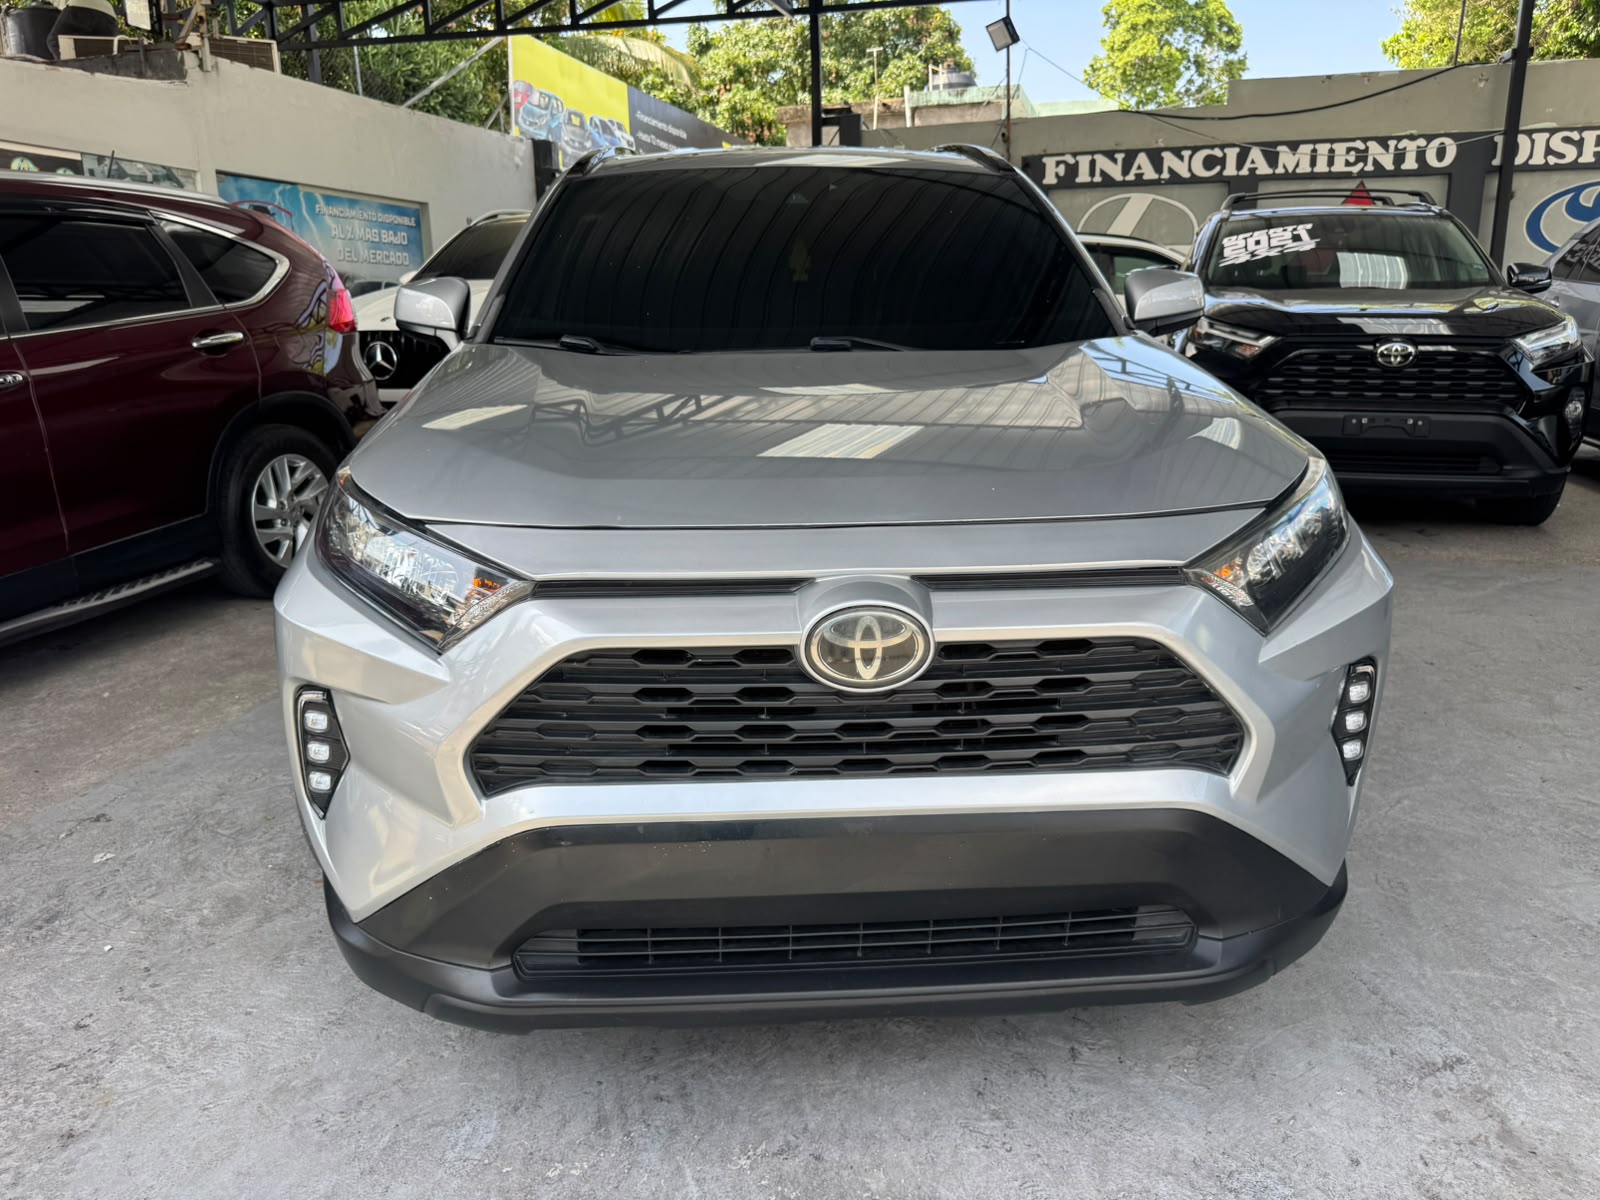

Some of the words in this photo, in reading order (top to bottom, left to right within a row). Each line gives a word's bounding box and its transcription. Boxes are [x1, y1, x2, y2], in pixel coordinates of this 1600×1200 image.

[1042, 136, 1458, 185] FINANCIAMIENTO
[316, 204, 376, 222] FINANCIAMIENTO
[377, 212, 416, 227] DISPONIBLE
[331, 223, 345, 239] AL
[356, 226, 379, 242] MAS
[381, 228, 408, 245] BAJO
[1223, 228, 1312, 258] 2021
[337, 247, 358, 262] DEL
[359, 247, 410, 266] MERCADO
